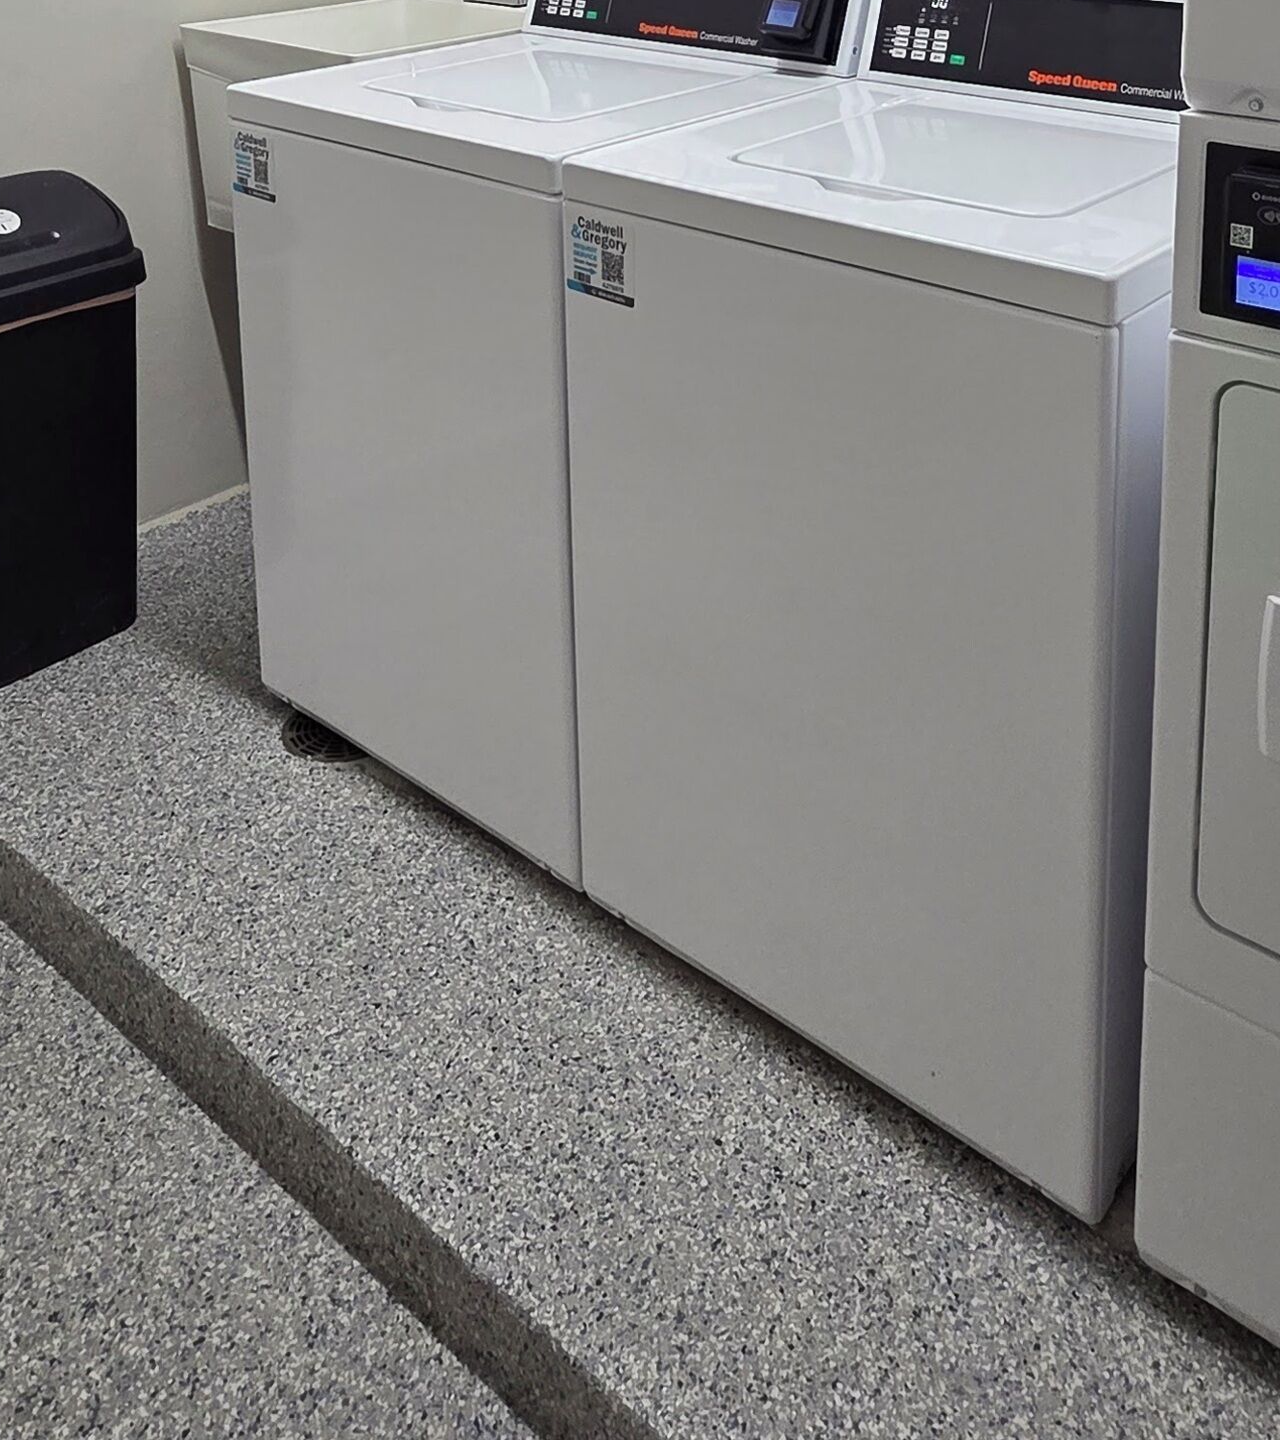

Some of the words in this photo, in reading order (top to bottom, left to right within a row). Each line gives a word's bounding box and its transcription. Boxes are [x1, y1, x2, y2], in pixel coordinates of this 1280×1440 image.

[638, 23, 668, 35] Speed
[668, 26, 698, 39] Queen
[700, 31, 735, 43] Commercial
[735, 36, 759, 46] Washer
[1028, 70, 1071, 86] Speed
[1072, 75, 1117, 92] Queen
[1120, 83, 1172, 99] Commercial
[237, 131, 267, 148] Caldwell
[571, 223, 627, 255] &Gregory
[577, 215, 624, 239] Caldwell
